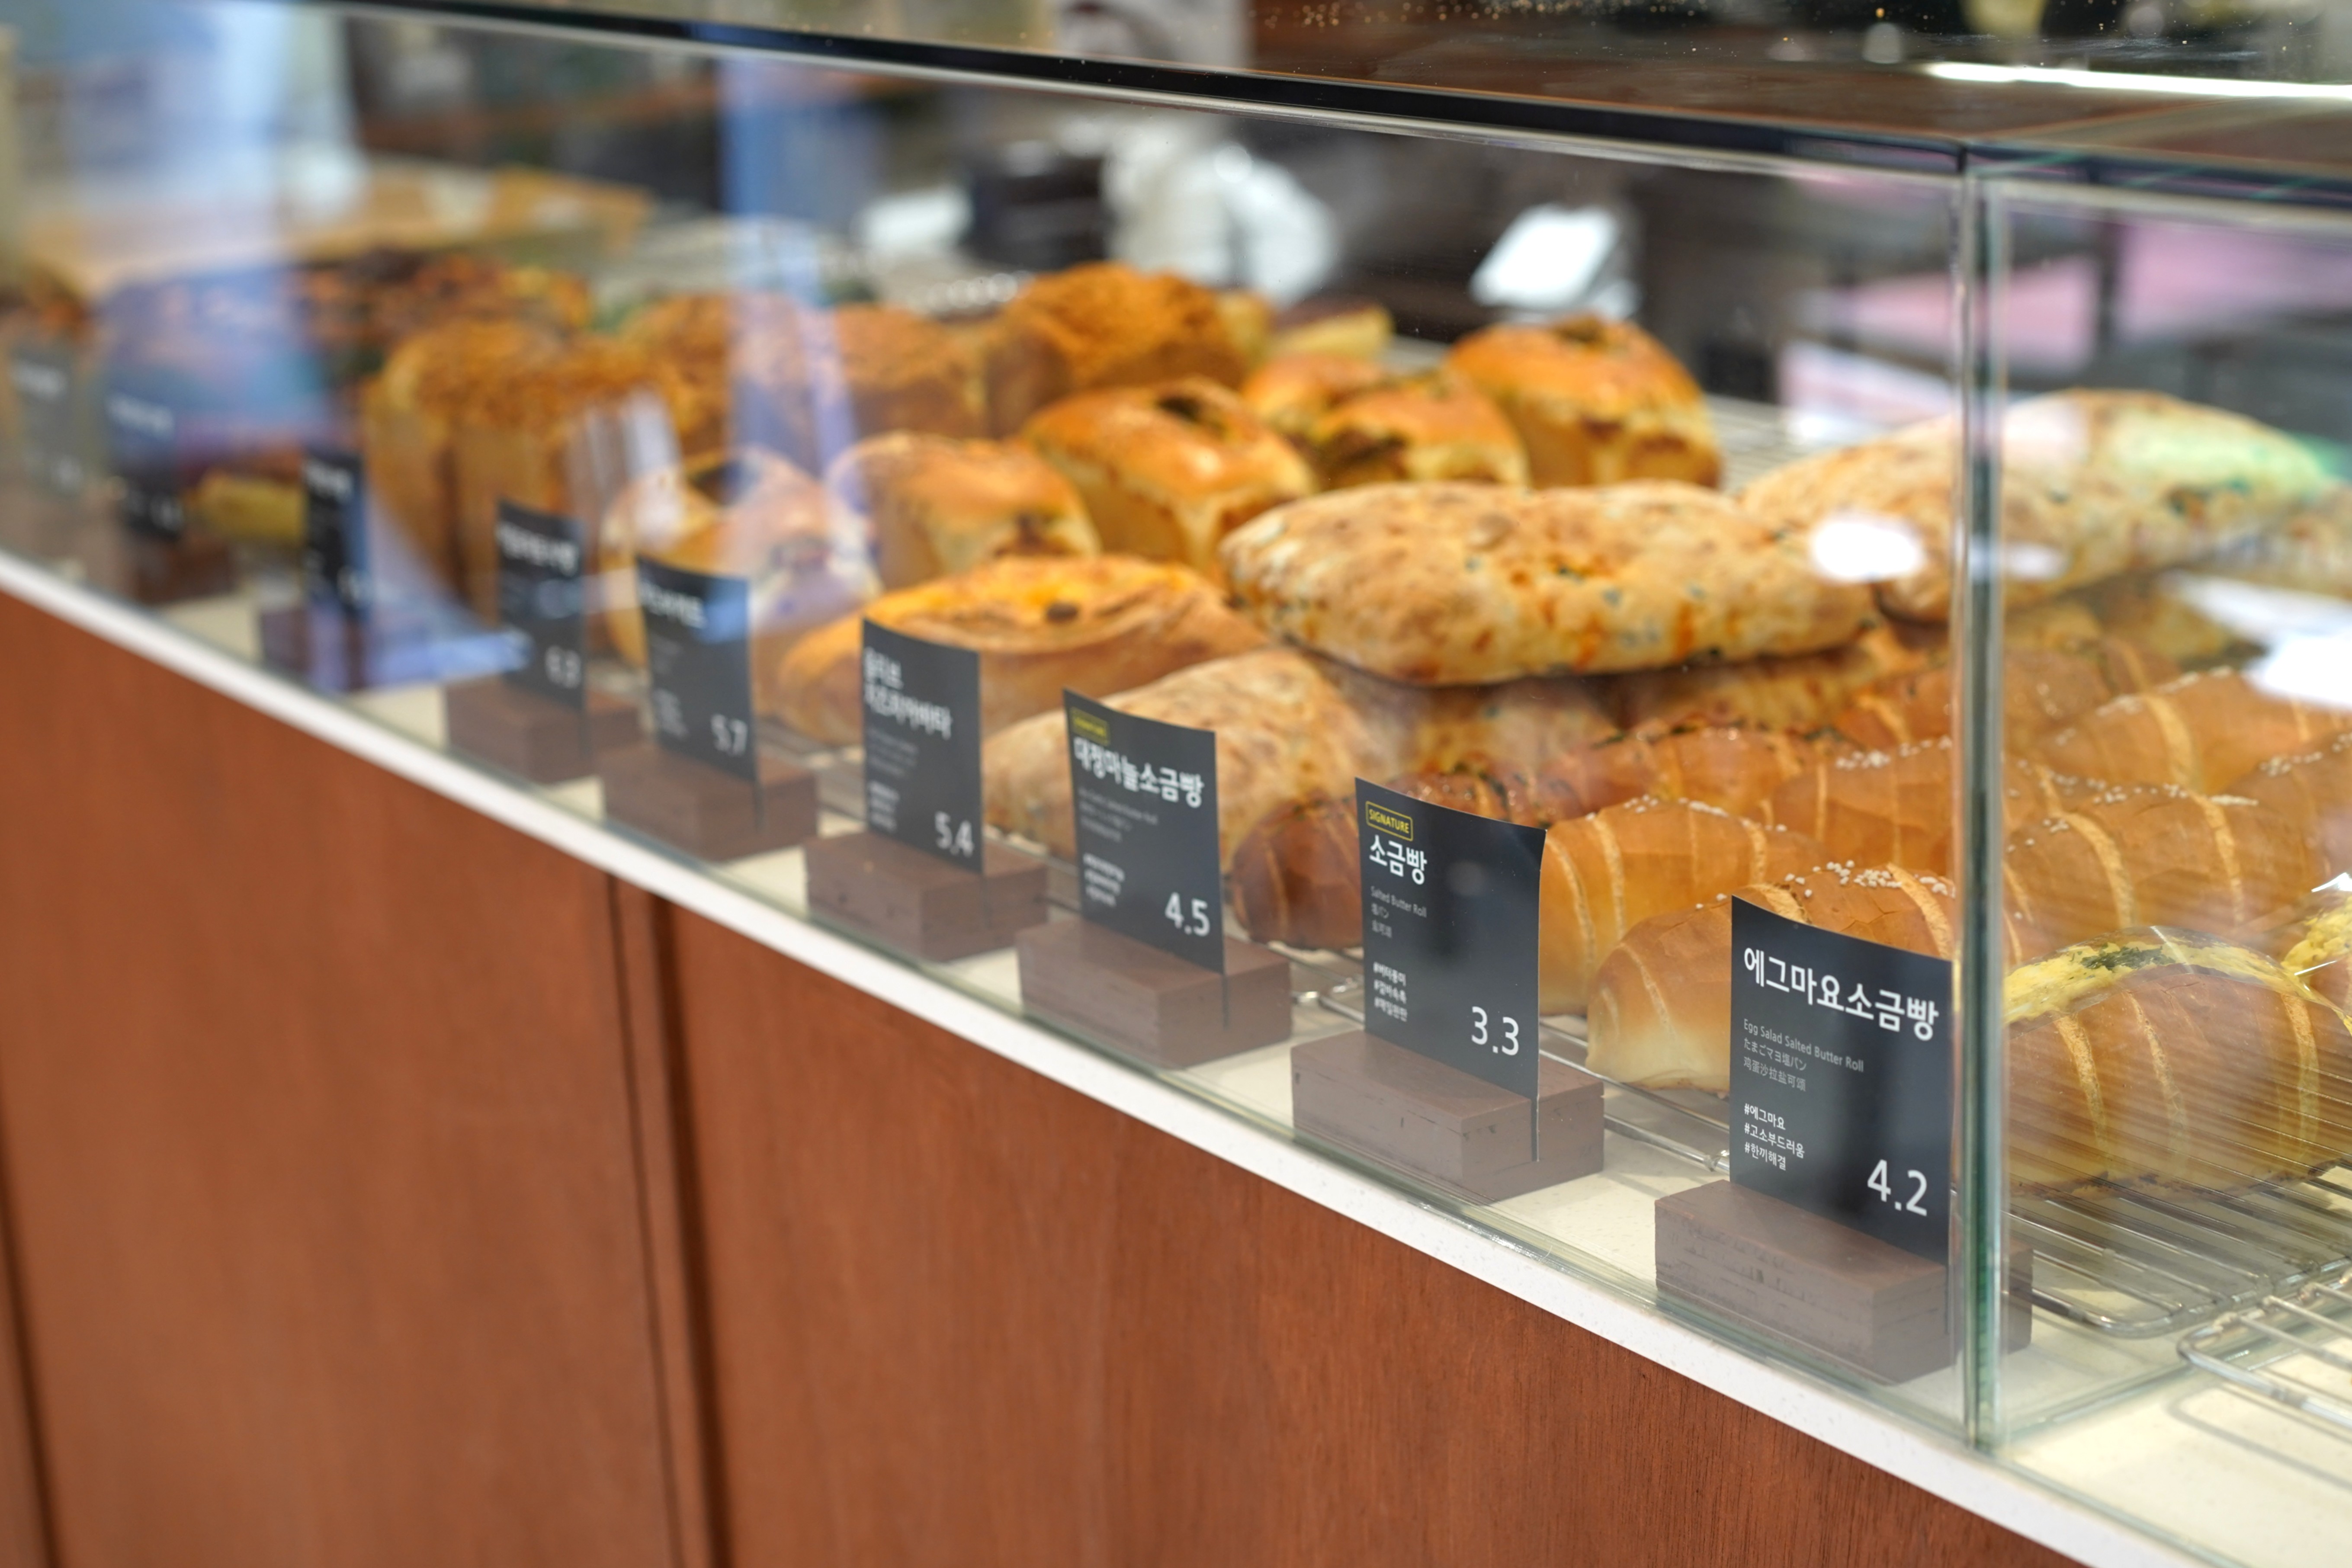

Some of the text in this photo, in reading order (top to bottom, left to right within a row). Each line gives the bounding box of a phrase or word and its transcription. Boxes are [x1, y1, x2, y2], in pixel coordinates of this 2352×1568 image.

[1073, 736, 1205, 808] 대정마늘소금빵
[935, 811, 974, 857] 5.4
[1369, 809, 1409, 834] SIGNATURE
[1369, 834, 1427, 885] 소금빵
[1165, 891, 1210, 936] 4.5
[1370, 886, 1427, 918] Salted Butter Roll
[1744, 947, 1939, 1042] 에그마요소금빵
[1472, 1006, 1519, 1055] 3.3
[1744, 1019, 1864, 1072] Egg Salad Salted Butter Roll
[1744, 1037, 1807, 1071] たまごマヨ塩パン
[1744, 1056, 1806, 1091] 鸡蛋沙拉盐可颂
[1744, 1103, 1786, 1130] #에그마요
[1744, 1122, 1805, 1158] #고소부드러움
[1745, 1142, 1786, 1170] #한끼해결
[1867, 1159, 1927, 1216] 4.2
